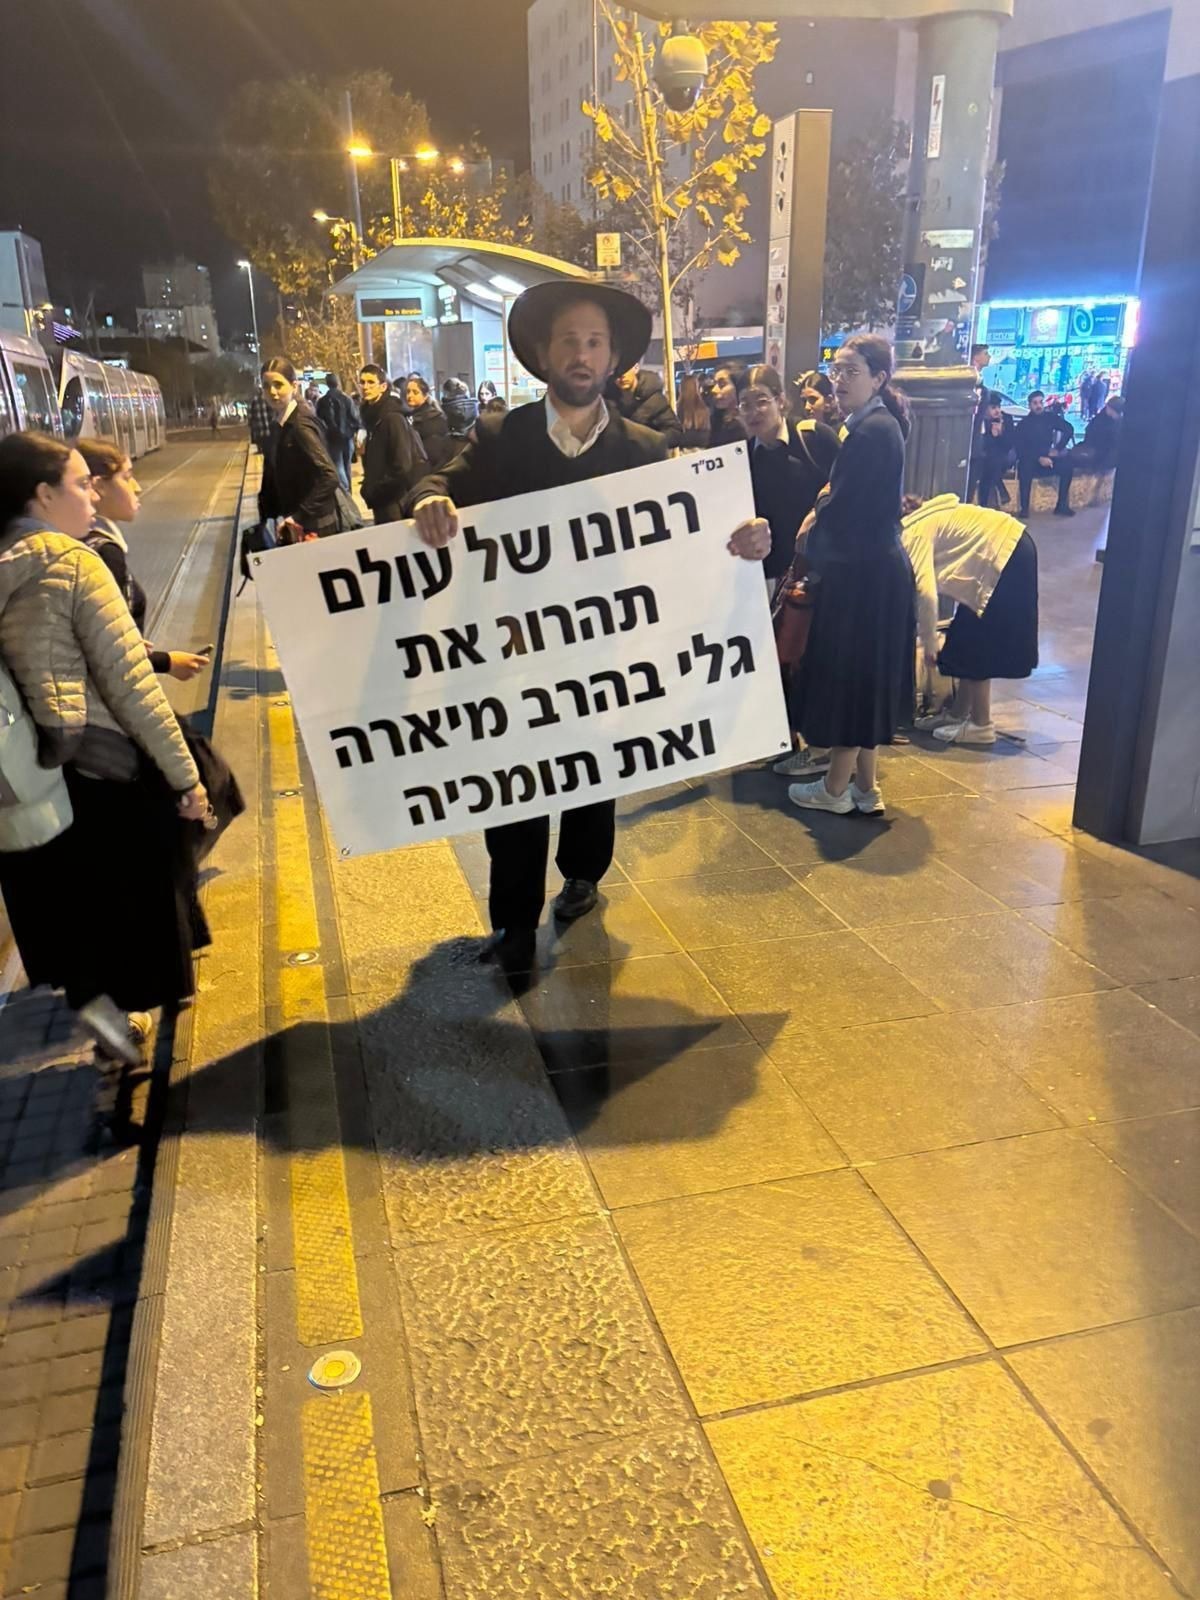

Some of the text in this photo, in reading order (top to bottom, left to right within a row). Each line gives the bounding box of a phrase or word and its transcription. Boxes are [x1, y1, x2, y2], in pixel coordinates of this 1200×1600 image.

[691, 457, 725, 475] בס"ד
[317, 491, 701, 615] רבונו של עולם
[394, 585, 660, 679] תהרוג את
[328, 633, 756, 769] גלי בהרב מיארה
[402, 718, 717, 826] ואת תומכיה
